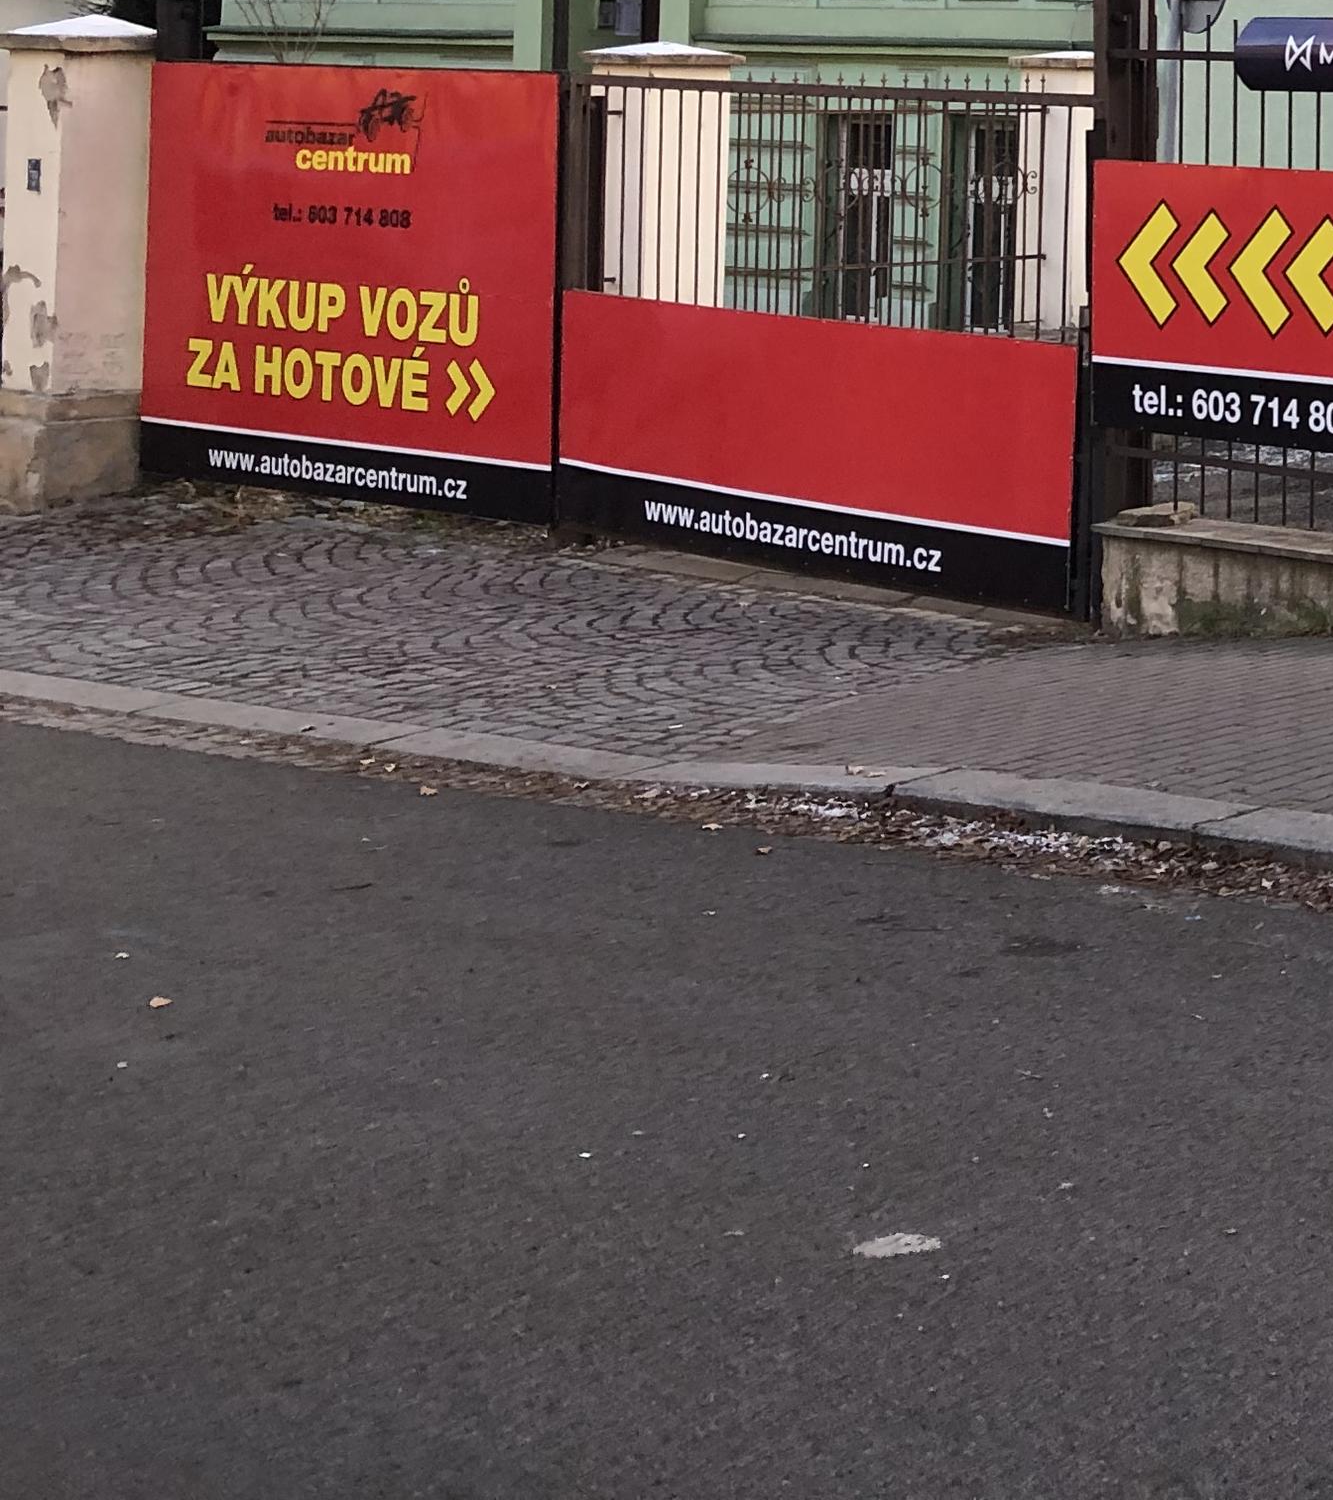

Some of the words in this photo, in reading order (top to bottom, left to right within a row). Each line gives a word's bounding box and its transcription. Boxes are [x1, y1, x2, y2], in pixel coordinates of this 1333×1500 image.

[266, 127, 355, 146] autobazar
[296, 147, 410, 173] centrum
[308, 206, 337, 224] 603
[344, 207, 373, 226] 714
[379, 209, 411, 228] 808
[208, 264, 345, 331] VÝKUP
[360, 279, 478, 348] VOZŮ
[187, 339, 240, 390] ZA
[255, 346, 428, 411] HOTOVÉ
[1133, 385, 1182, 416] tel.:
[1192, 389, 1240, 423] 603
[1251, 395, 1299, 429] 714
[209, 449, 466, 499] www.autobazarcentrum.cz
[645, 501, 941, 571] www.autobazarcentrum.cz
